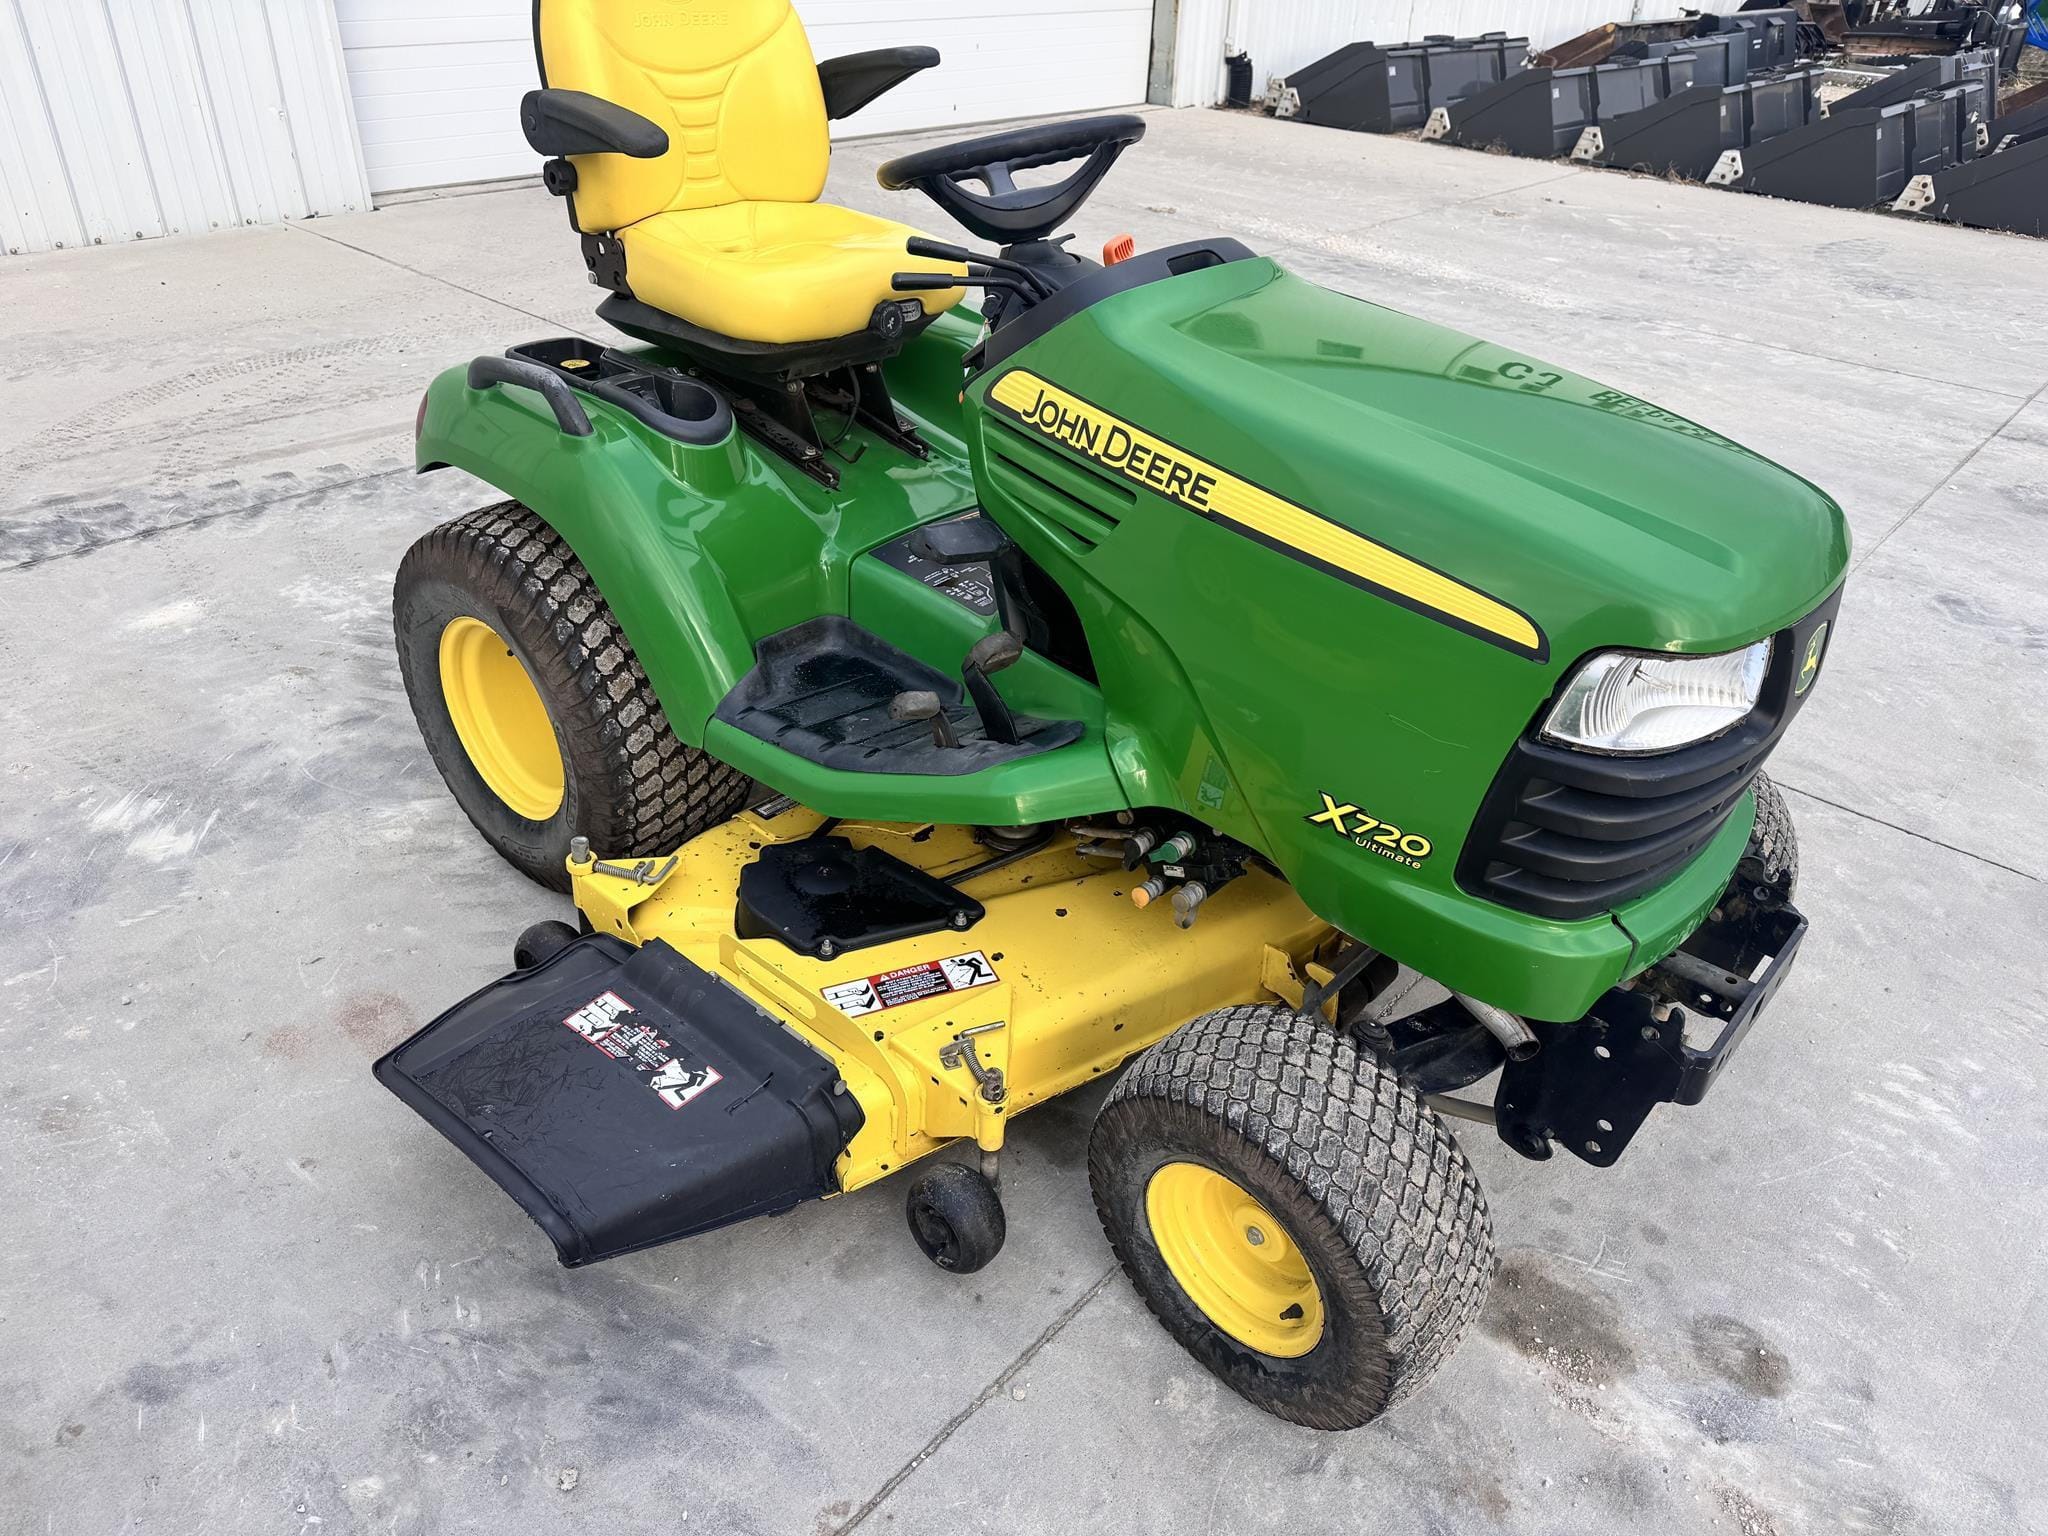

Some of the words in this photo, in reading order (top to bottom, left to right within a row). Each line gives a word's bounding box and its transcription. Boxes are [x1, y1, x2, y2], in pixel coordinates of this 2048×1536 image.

[633, 9, 674, 28] JOHN
[679, 8, 729, 27] DEERE
[1022, 389, 1102, 452] JOHN
[1101, 424, 1217, 508] DEERE
[1304, 791, 1433, 858] X720
[1355, 836, 1422, 870] Ultimate
[889, 963, 931, 979] DANGER
